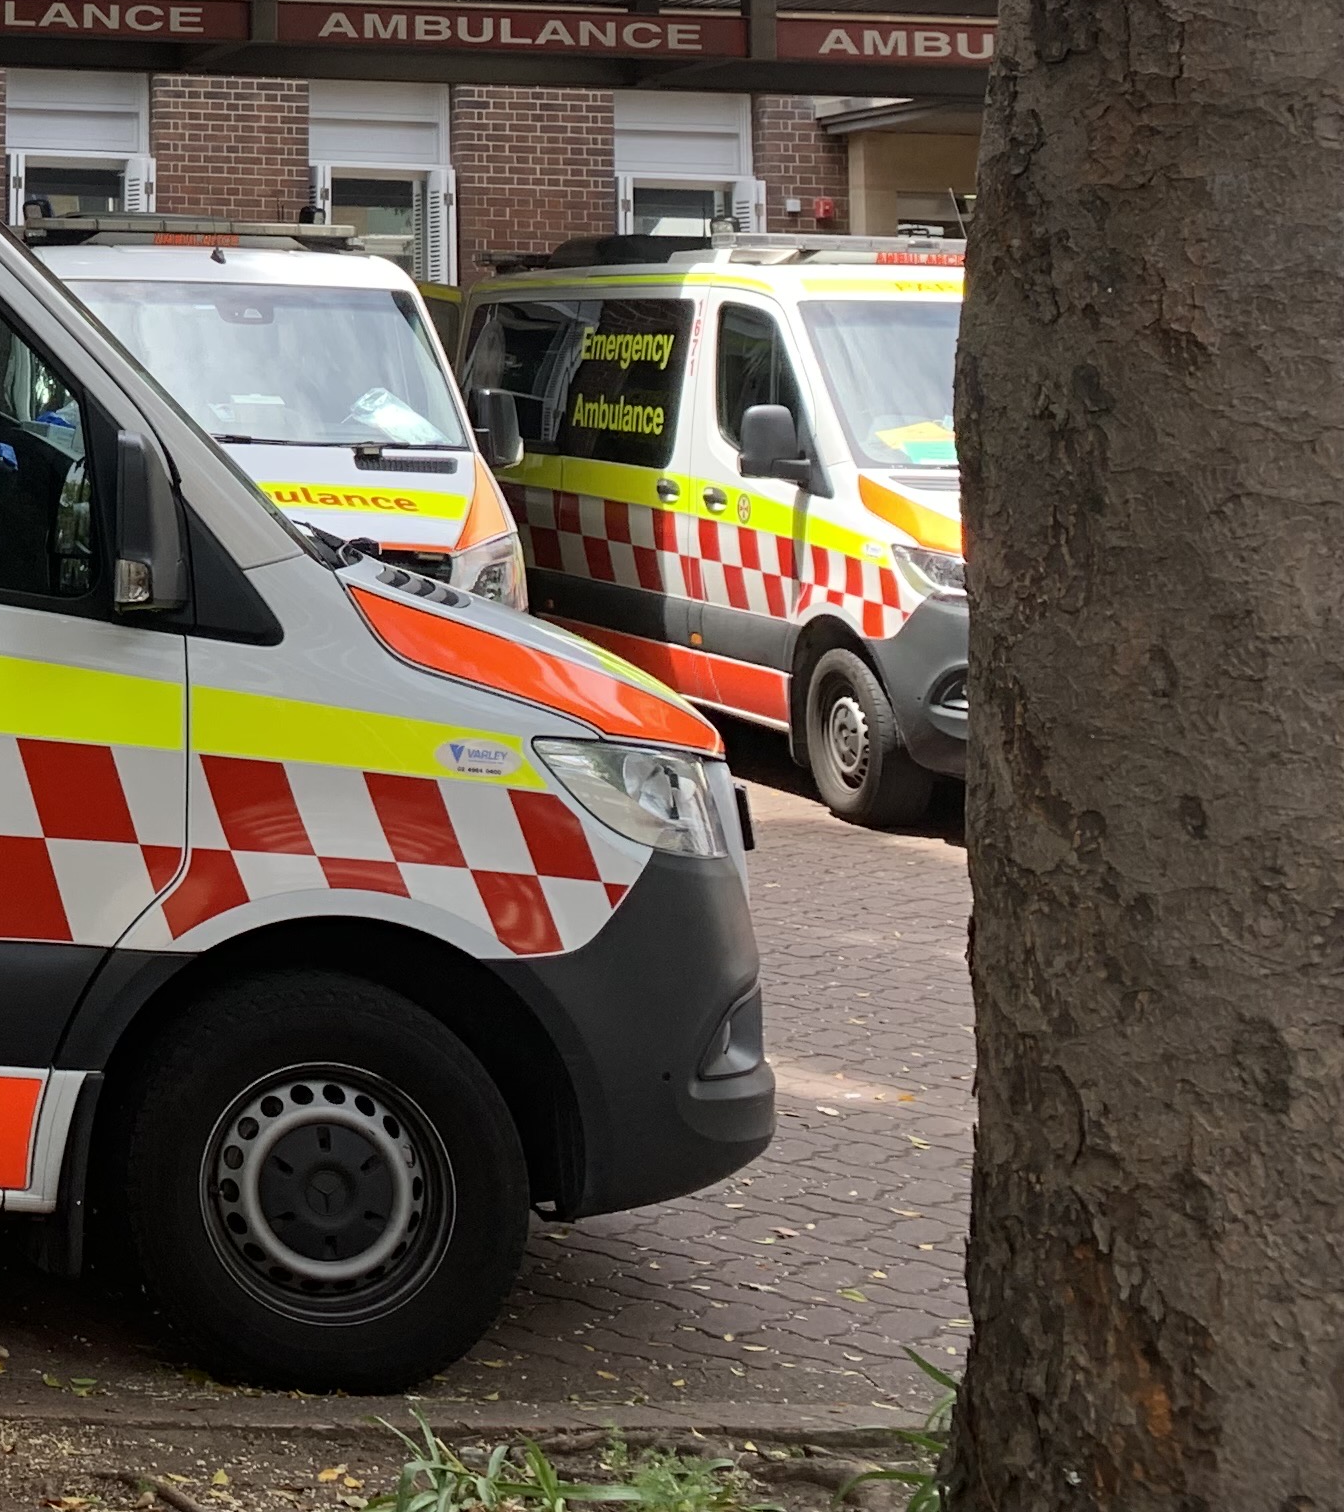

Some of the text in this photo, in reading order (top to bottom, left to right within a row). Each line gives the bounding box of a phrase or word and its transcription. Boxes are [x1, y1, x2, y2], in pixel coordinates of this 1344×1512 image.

[318, 11, 703, 51] AMBULANCE
[581, 326, 675, 370] Emergency
[690, 299, 704, 377] 1671
[572, 392, 665, 436] Ambulance
[263, 487, 420, 512] ulance
[467, 749, 508, 760] VARLEY
